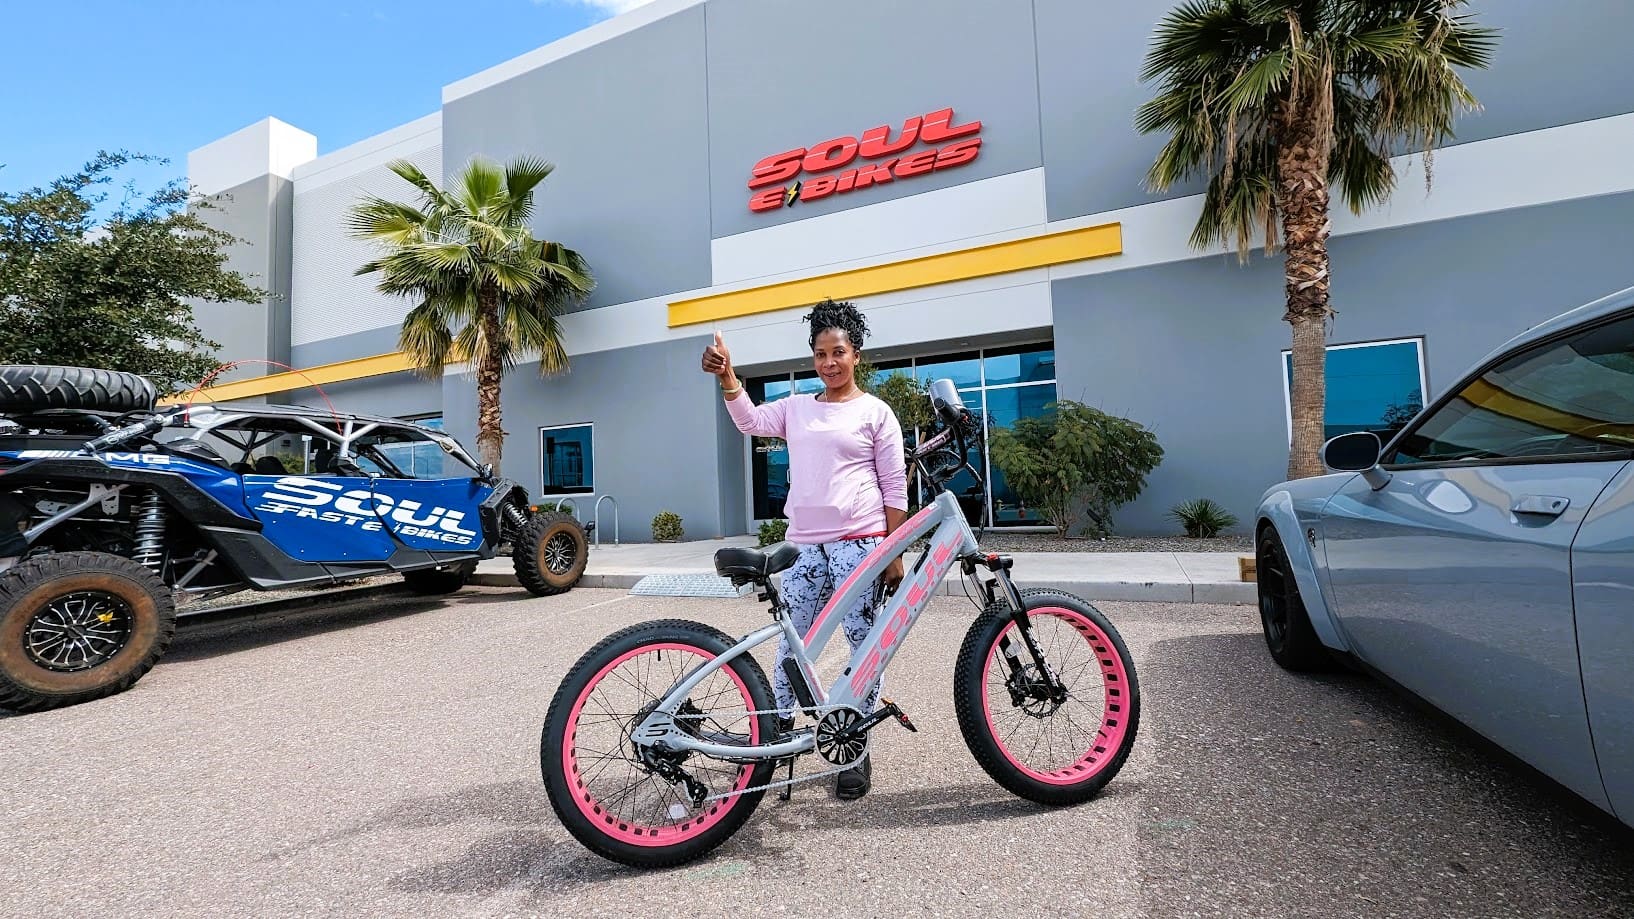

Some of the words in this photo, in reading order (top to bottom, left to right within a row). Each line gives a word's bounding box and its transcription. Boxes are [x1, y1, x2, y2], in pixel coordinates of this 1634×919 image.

[748, 107, 982, 189] SOUL
[800, 137, 982, 202] BIKES
[254, 502, 364, 526] FAST
[400, 525, 473, 545] BIKES
[261, 477, 476, 536] SOUL
[851, 530, 964, 698] SOUL
